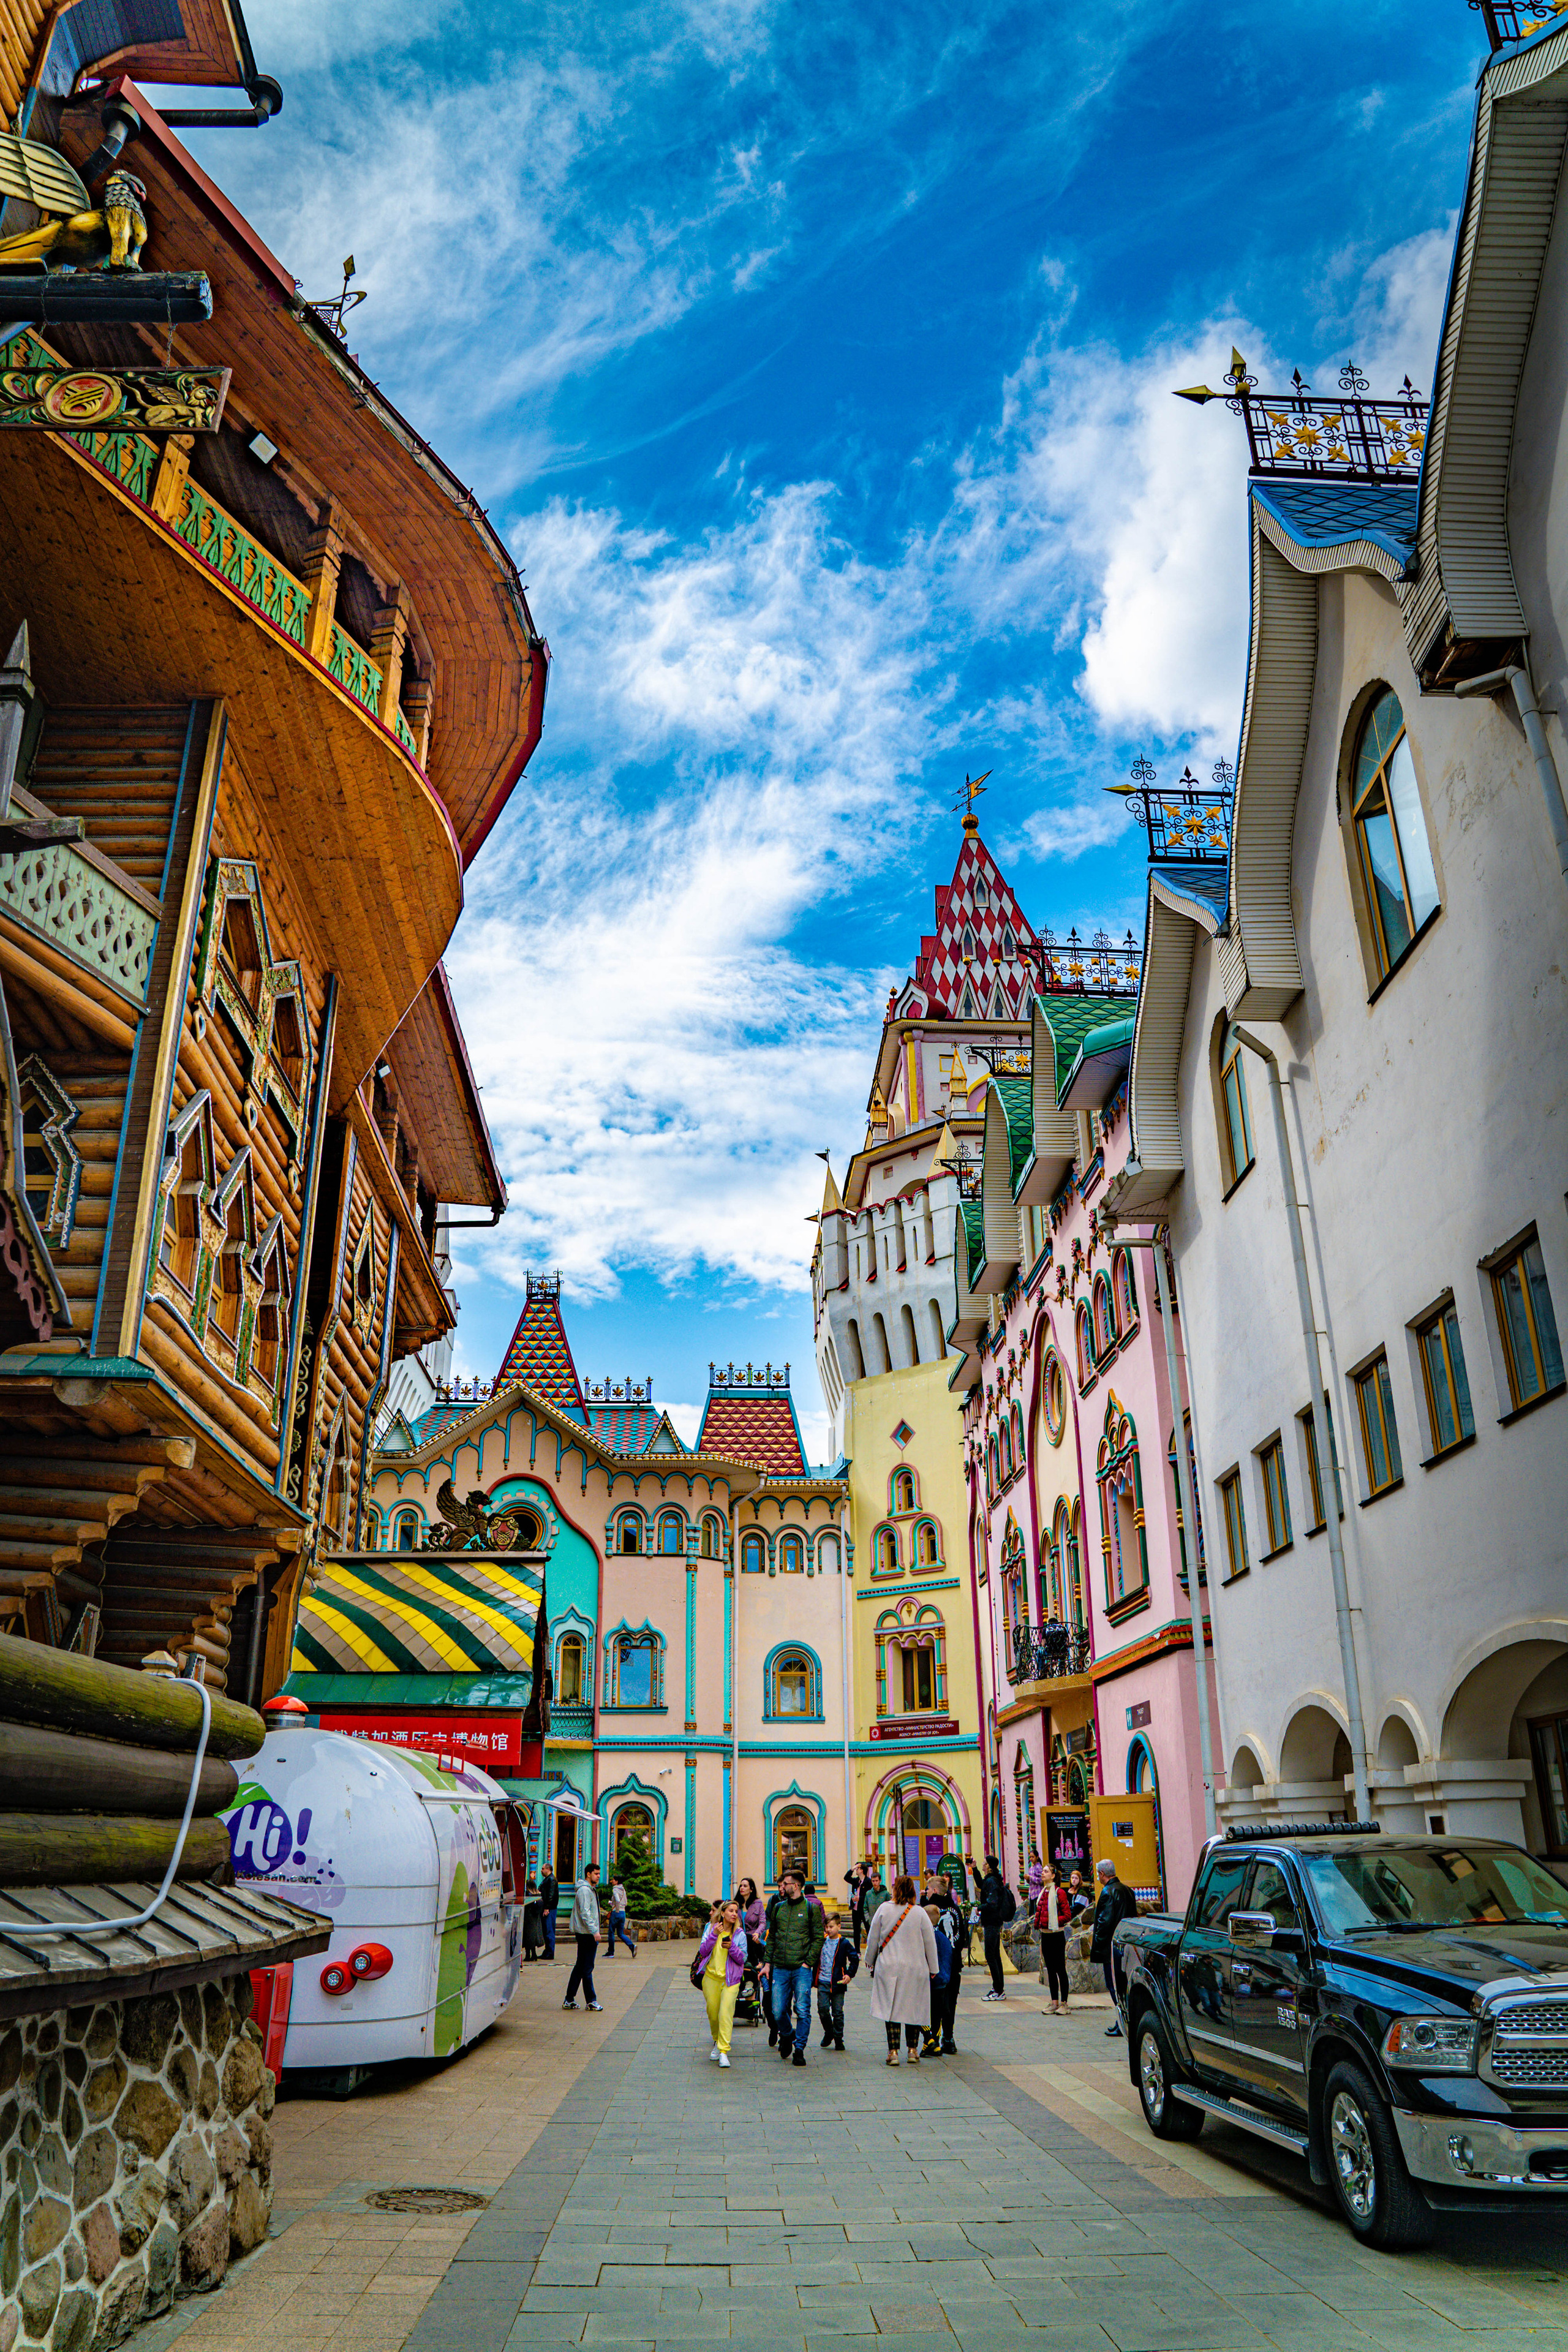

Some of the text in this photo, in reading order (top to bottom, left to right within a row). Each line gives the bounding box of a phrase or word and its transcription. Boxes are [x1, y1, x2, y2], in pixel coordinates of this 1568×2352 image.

[234, 1804, 312, 1871] Hi!
[1277, 2007, 1296, 2020] RAM
[1278, 2016, 1296, 2030] 1500
